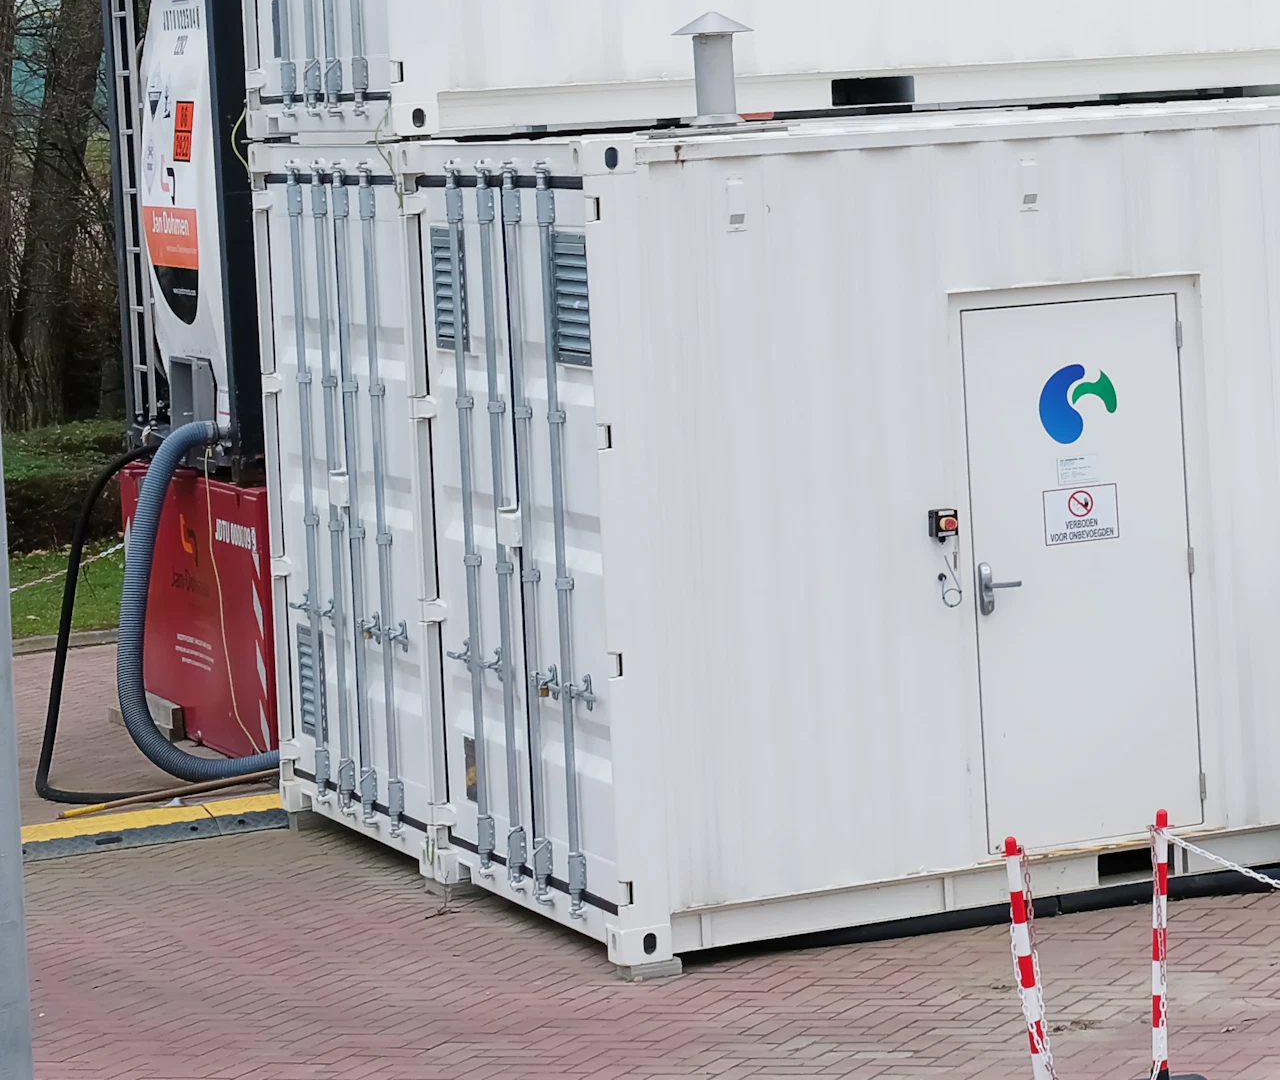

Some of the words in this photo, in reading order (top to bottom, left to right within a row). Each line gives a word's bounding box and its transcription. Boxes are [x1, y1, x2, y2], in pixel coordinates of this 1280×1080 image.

[1065, 518, 1098, 530] VERBODEN
[1050, 532, 1068, 542] VOOR
[1068, 527, 1115, 540] ONBEVOEGDEN
